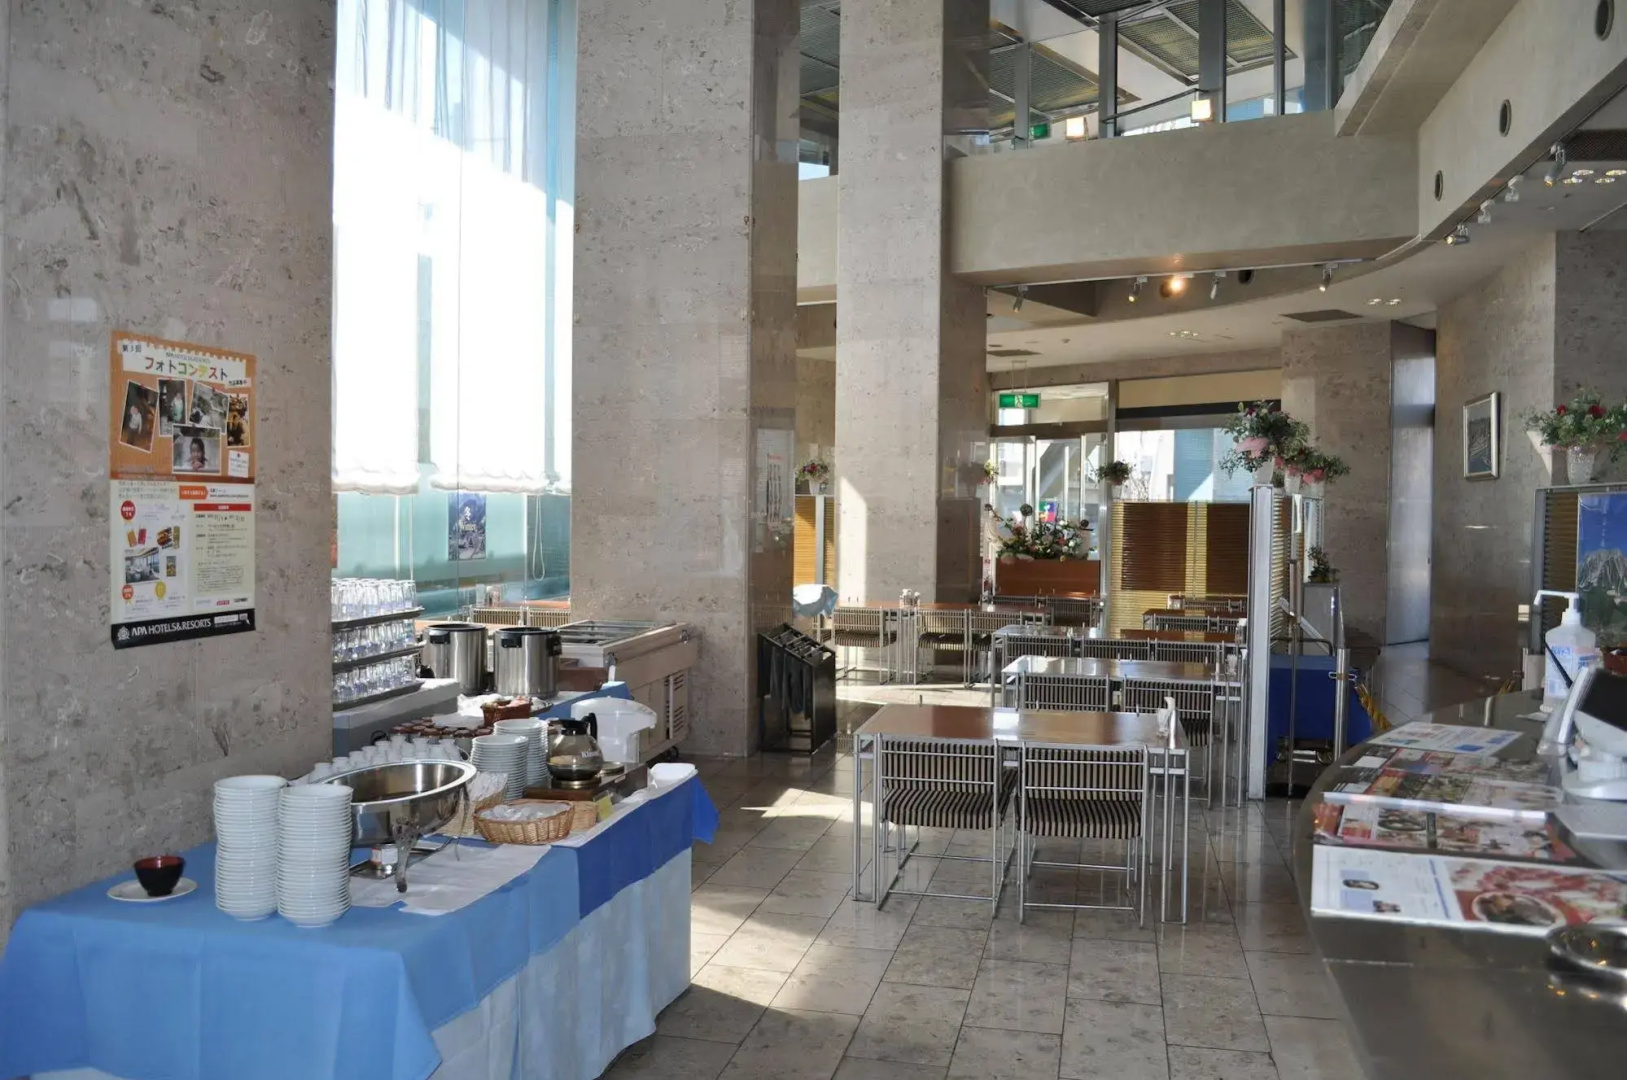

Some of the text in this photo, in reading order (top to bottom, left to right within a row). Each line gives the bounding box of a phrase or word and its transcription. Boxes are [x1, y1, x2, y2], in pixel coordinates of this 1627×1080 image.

[144, 357, 228, 381] フォトコンテスト
[131, 626, 148, 636] APA
[148, 618, 212, 635] HOTELS&RESORTS
